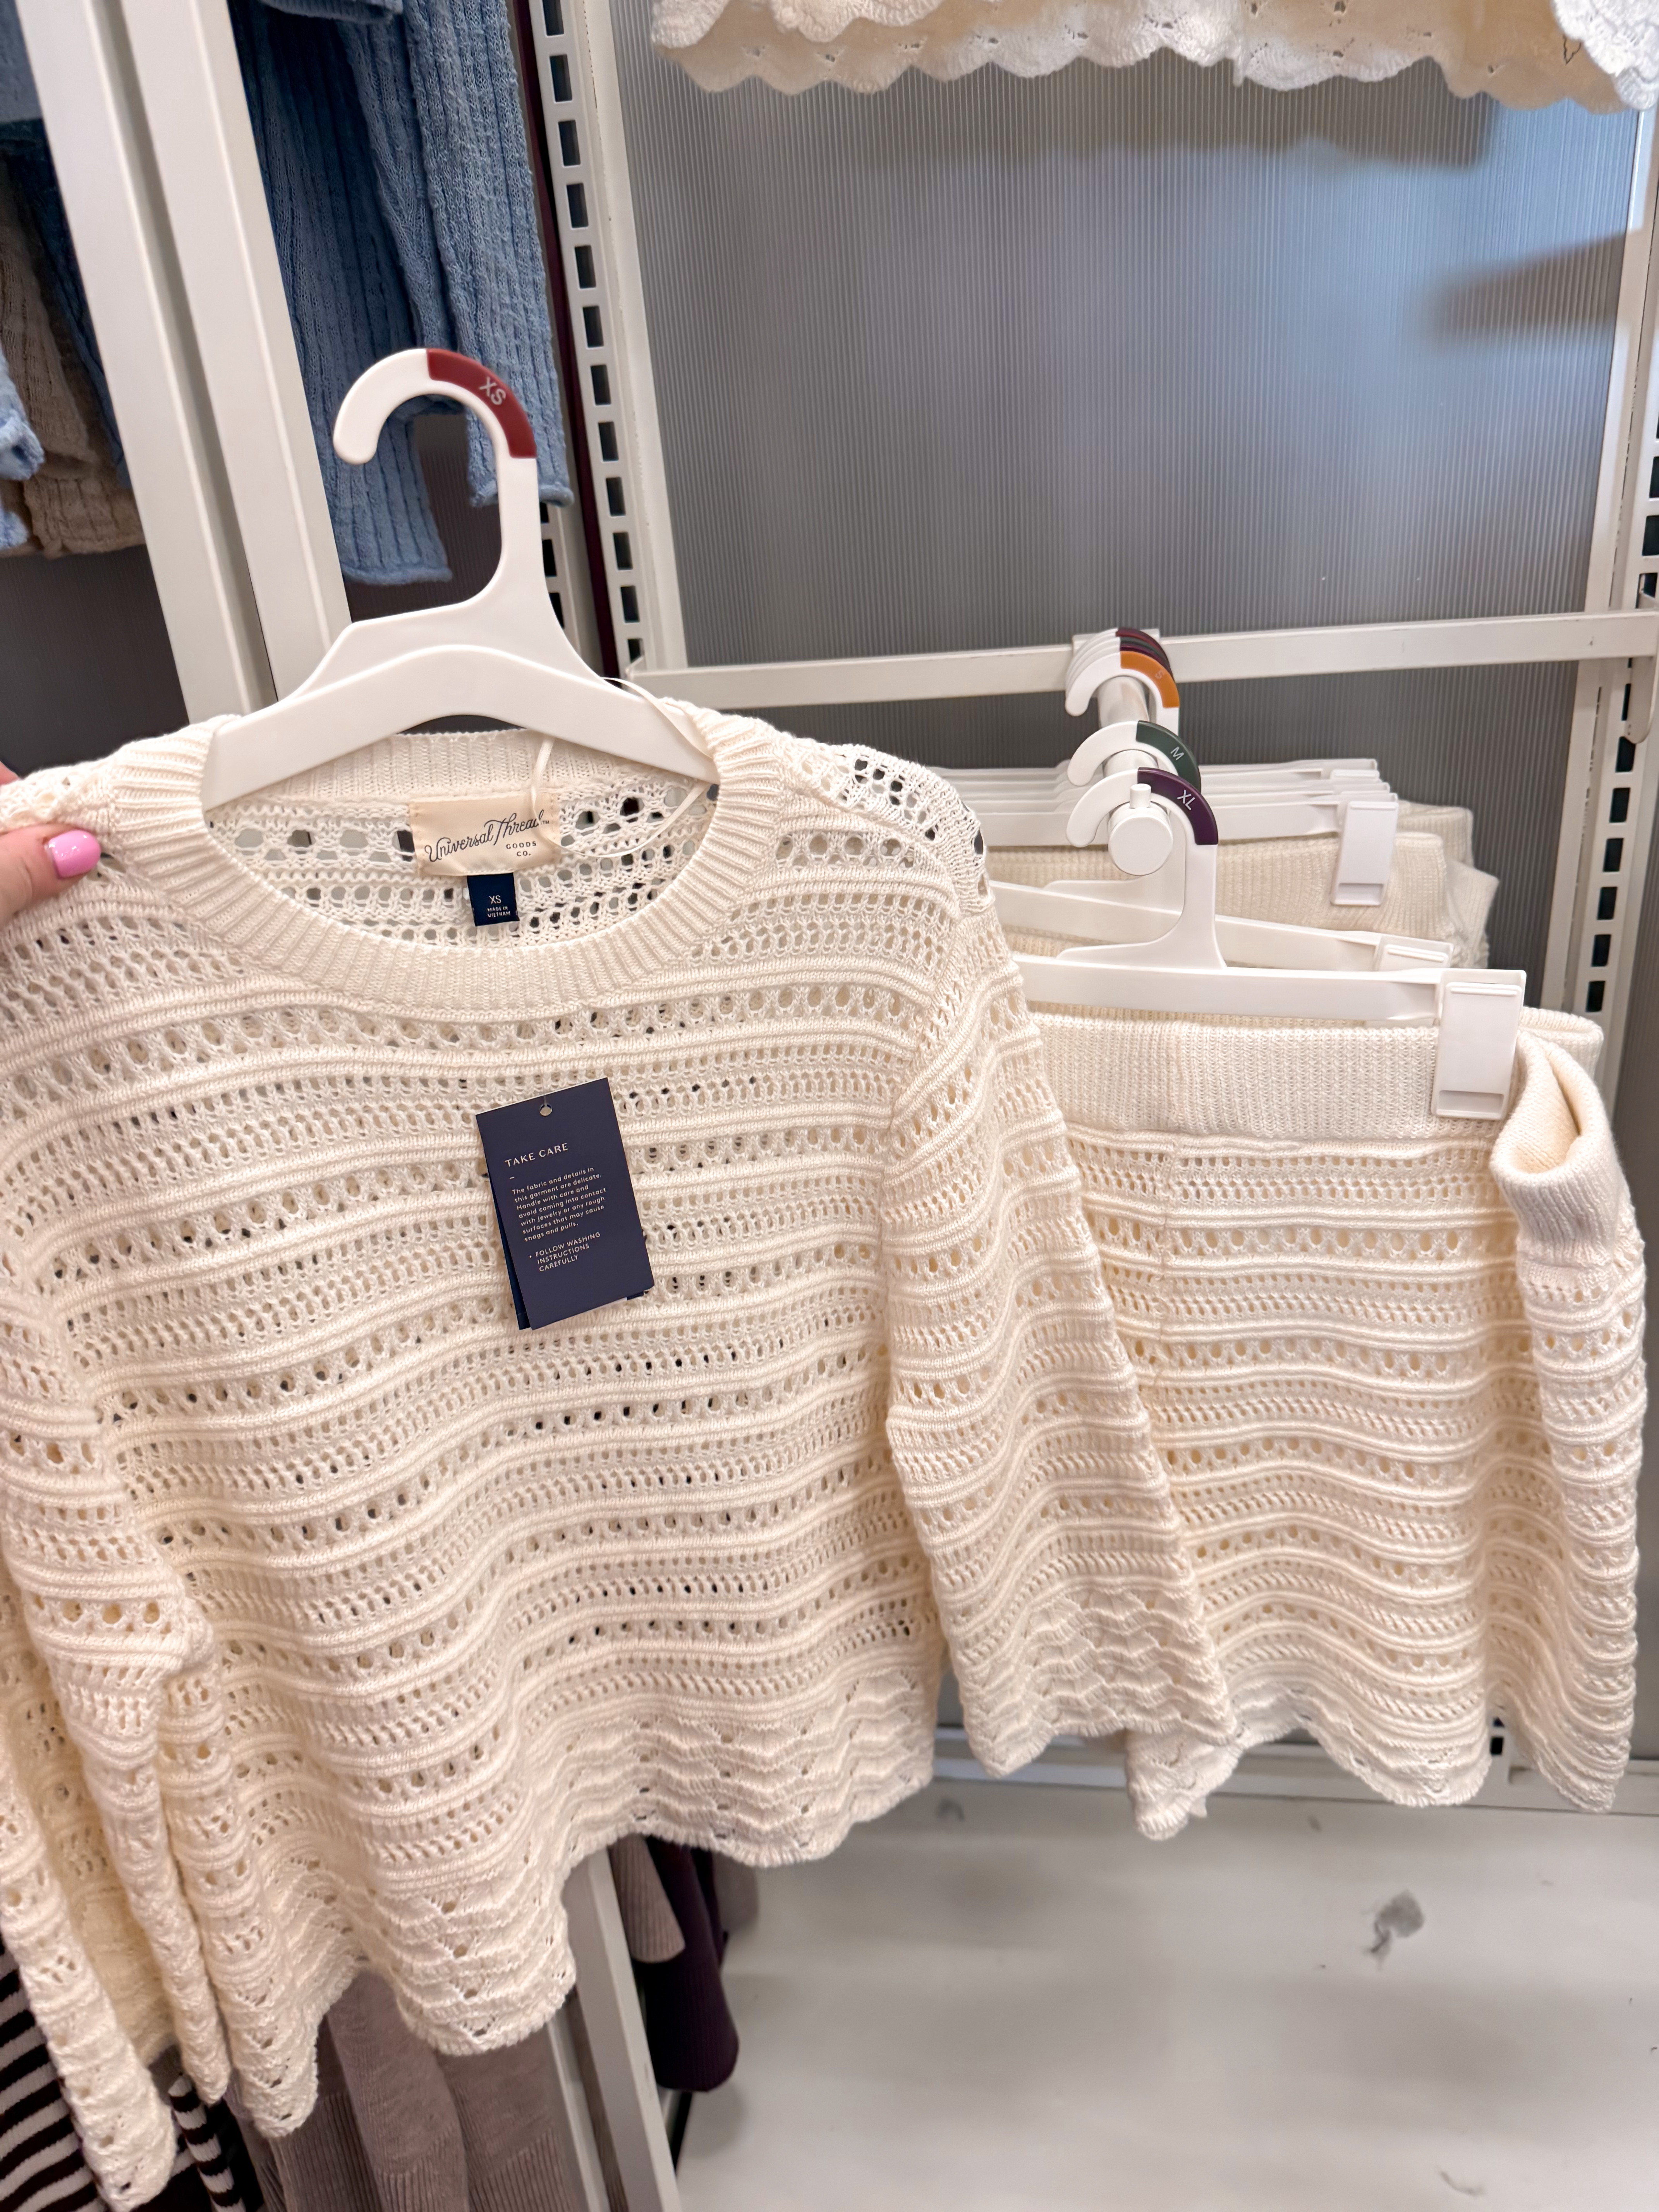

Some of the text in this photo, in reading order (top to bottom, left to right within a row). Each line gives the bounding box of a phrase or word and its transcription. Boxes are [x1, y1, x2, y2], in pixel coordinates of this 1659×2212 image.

[479, 376, 506, 405] XS
[1154, 669, 1164, 680] S
[1170, 746, 1184, 761] M
[1177, 789, 1195, 810] XL
[424, 823, 493, 862] Universal
[484, 809, 544, 846] Thread
[506, 841, 537, 849] GOODS
[489, 895, 501, 904] XS
[505, 1143, 568, 1167] TAKE CARE
[527, 1181, 547, 1191] fabric
[549, 1176, 562, 1184] and
[563, 1170, 586, 1180] details
[515, 1194, 527, 1203] this
[529, 1186, 558, 1200] garment
[517, 1199, 541, 1211] Handle
[543, 1194, 558, 1202] with
[576, 1184, 588, 1192] and
[519, 1208, 537, 1218] avoid
[539, 1201, 564, 1212] coming
[580, 1188, 606, 1199] contact
[520, 1218, 536, 1226] with
[538, 1210, 561, 1223] jewelry
[586, 1195, 605, 1206] rough
[523, 1205, 604, 1234] surfaces that may cause
[525, 1221, 578, 1242] snags and pulls.
[535, 1232, 600, 1257] FOLLOW WASHING
[537, 1243, 589, 1265] INSTRUCTIONS
[539, 1254, 578, 1272] CAREFULLY
